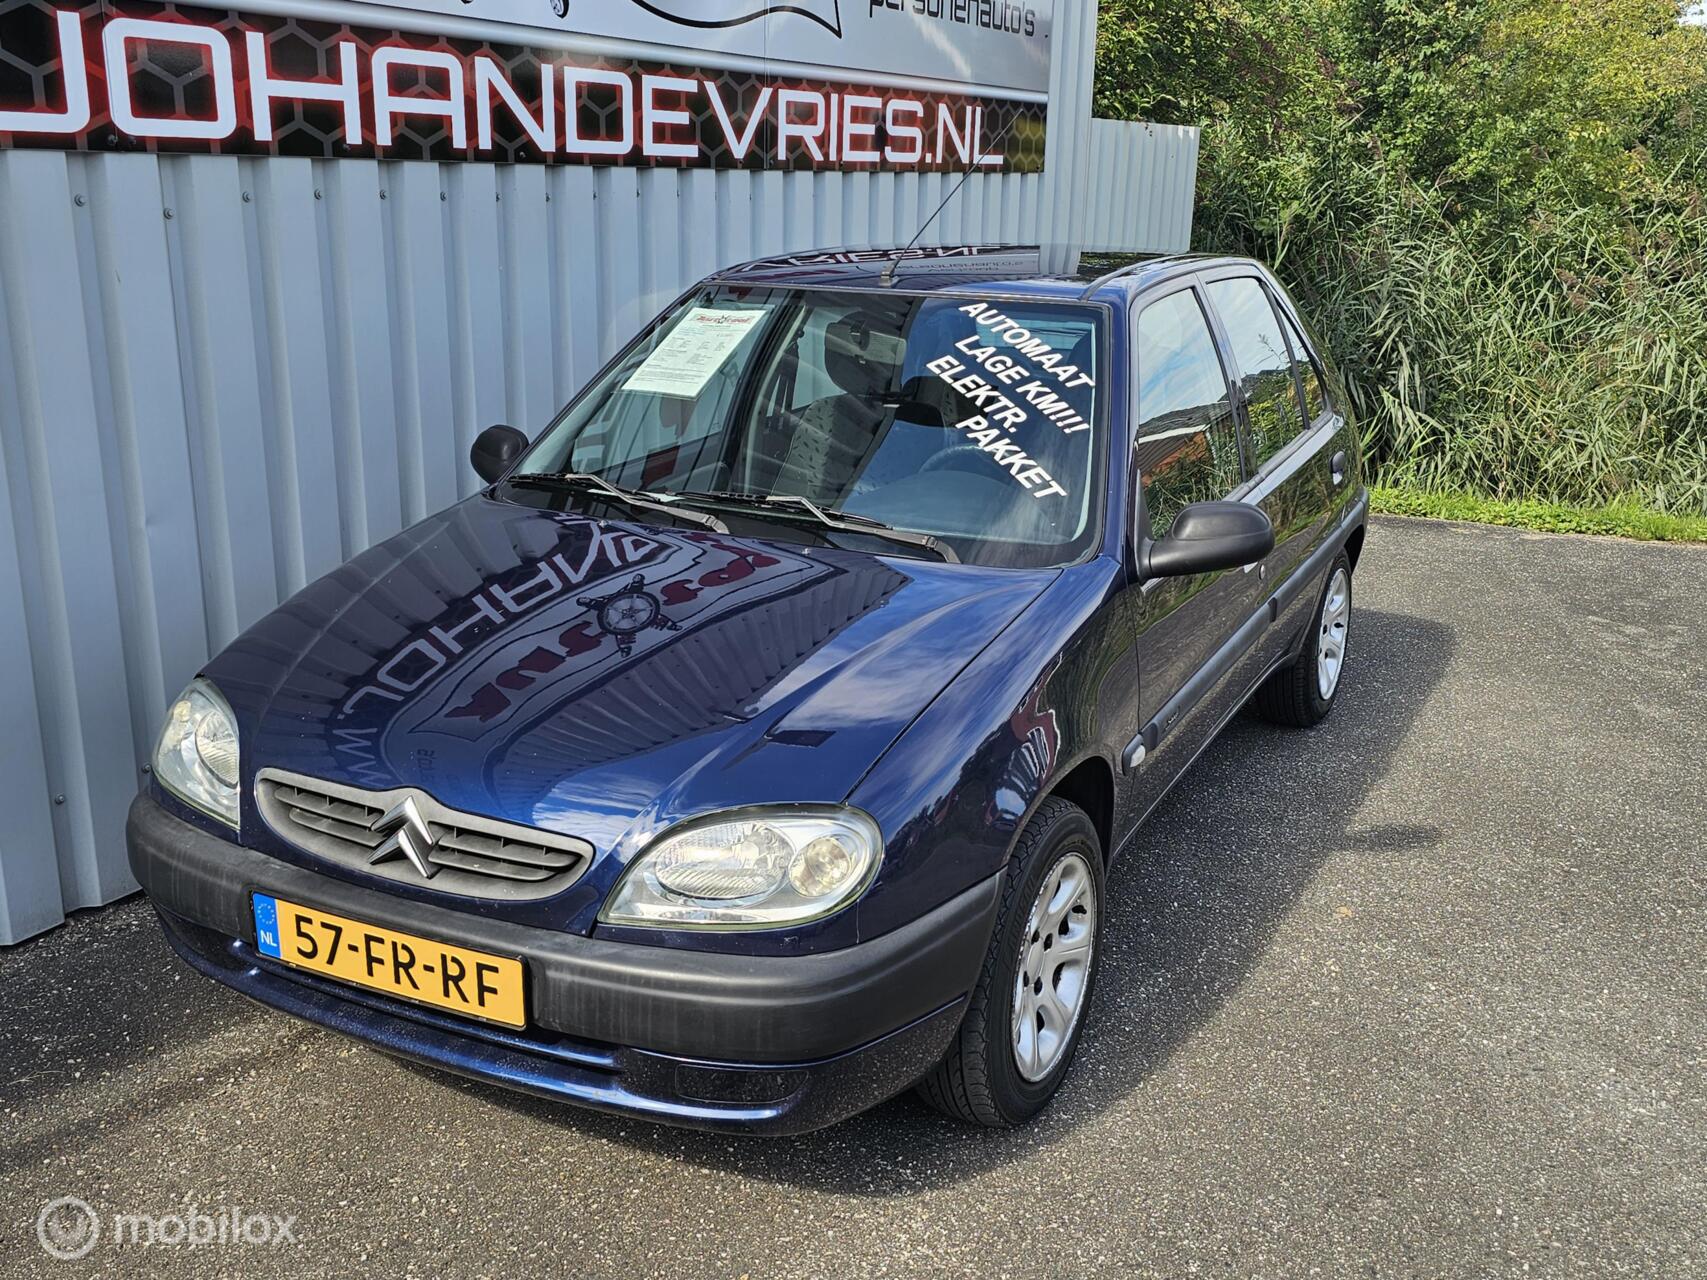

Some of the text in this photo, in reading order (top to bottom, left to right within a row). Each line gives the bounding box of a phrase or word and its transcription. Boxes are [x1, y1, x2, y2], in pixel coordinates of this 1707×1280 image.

[0, 10, 1004, 165] JOHANDEVRIES.NL
[954, 335, 1090, 434] LAGE KM!!!
[958, 302, 1096, 388] AUTOMAAT
[926, 354, 1028, 433] ELEKTR.
[955, 414, 1068, 498] PAKKET
[260, 931, 277, 947] NL
[294, 914, 500, 1008] 57-FR-RF
